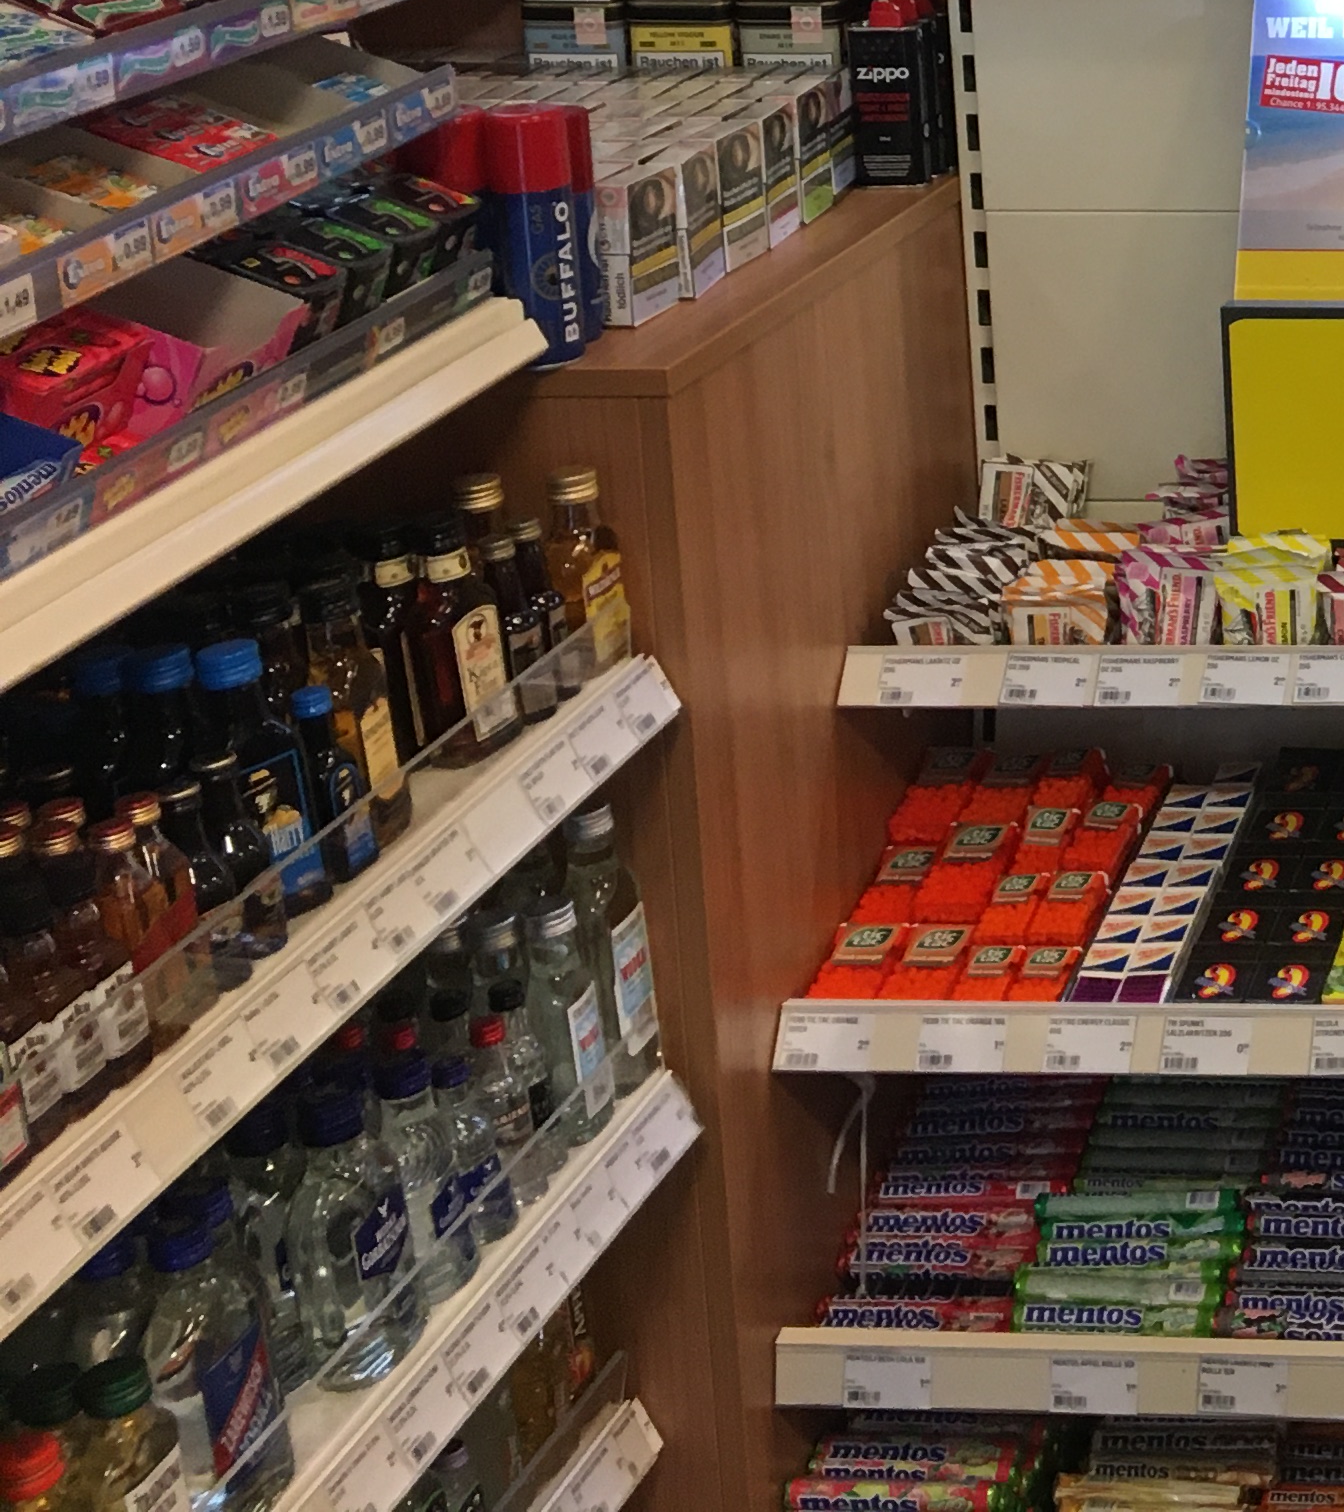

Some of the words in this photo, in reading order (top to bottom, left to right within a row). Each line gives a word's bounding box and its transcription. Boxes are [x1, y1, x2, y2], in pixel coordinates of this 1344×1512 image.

[856, 64, 910, 83] zippo
[1267, 59, 1318, 76] Jeden
[1266, 74, 1316, 92] Freitag
[552, 203, 580, 344] BUFFALO
[1024, 1306, 1142, 1328] mentos
